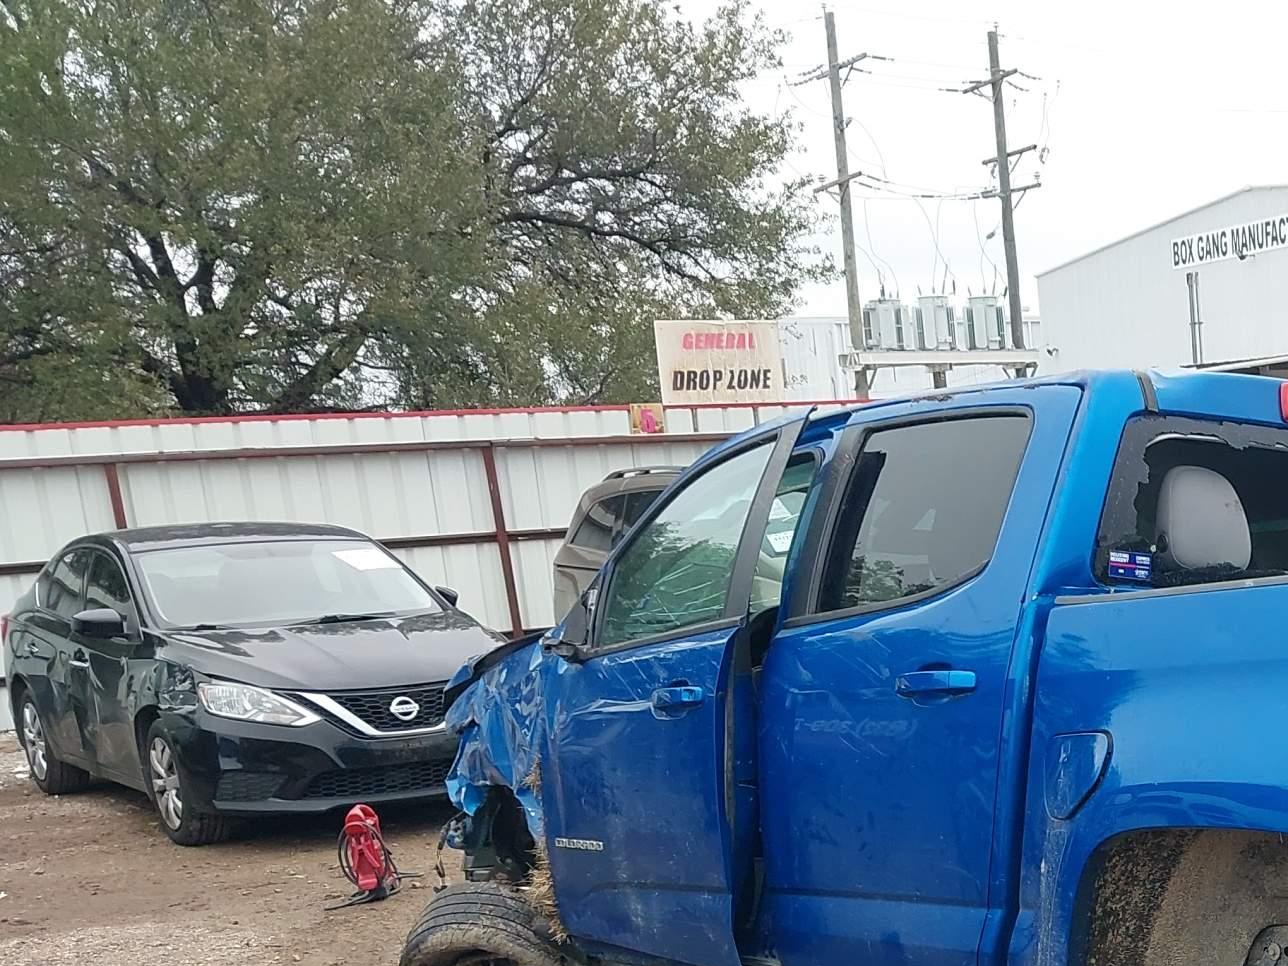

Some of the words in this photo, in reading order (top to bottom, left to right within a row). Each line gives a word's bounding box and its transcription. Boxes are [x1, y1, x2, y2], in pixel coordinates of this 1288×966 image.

[1172, 236, 1194, 266] BOX
[1197, 231, 1227, 261] GANG
[682, 332, 756, 349] GENERAL
[672, 370, 723, 391] DROP
[726, 369, 771, 390] ZONE
